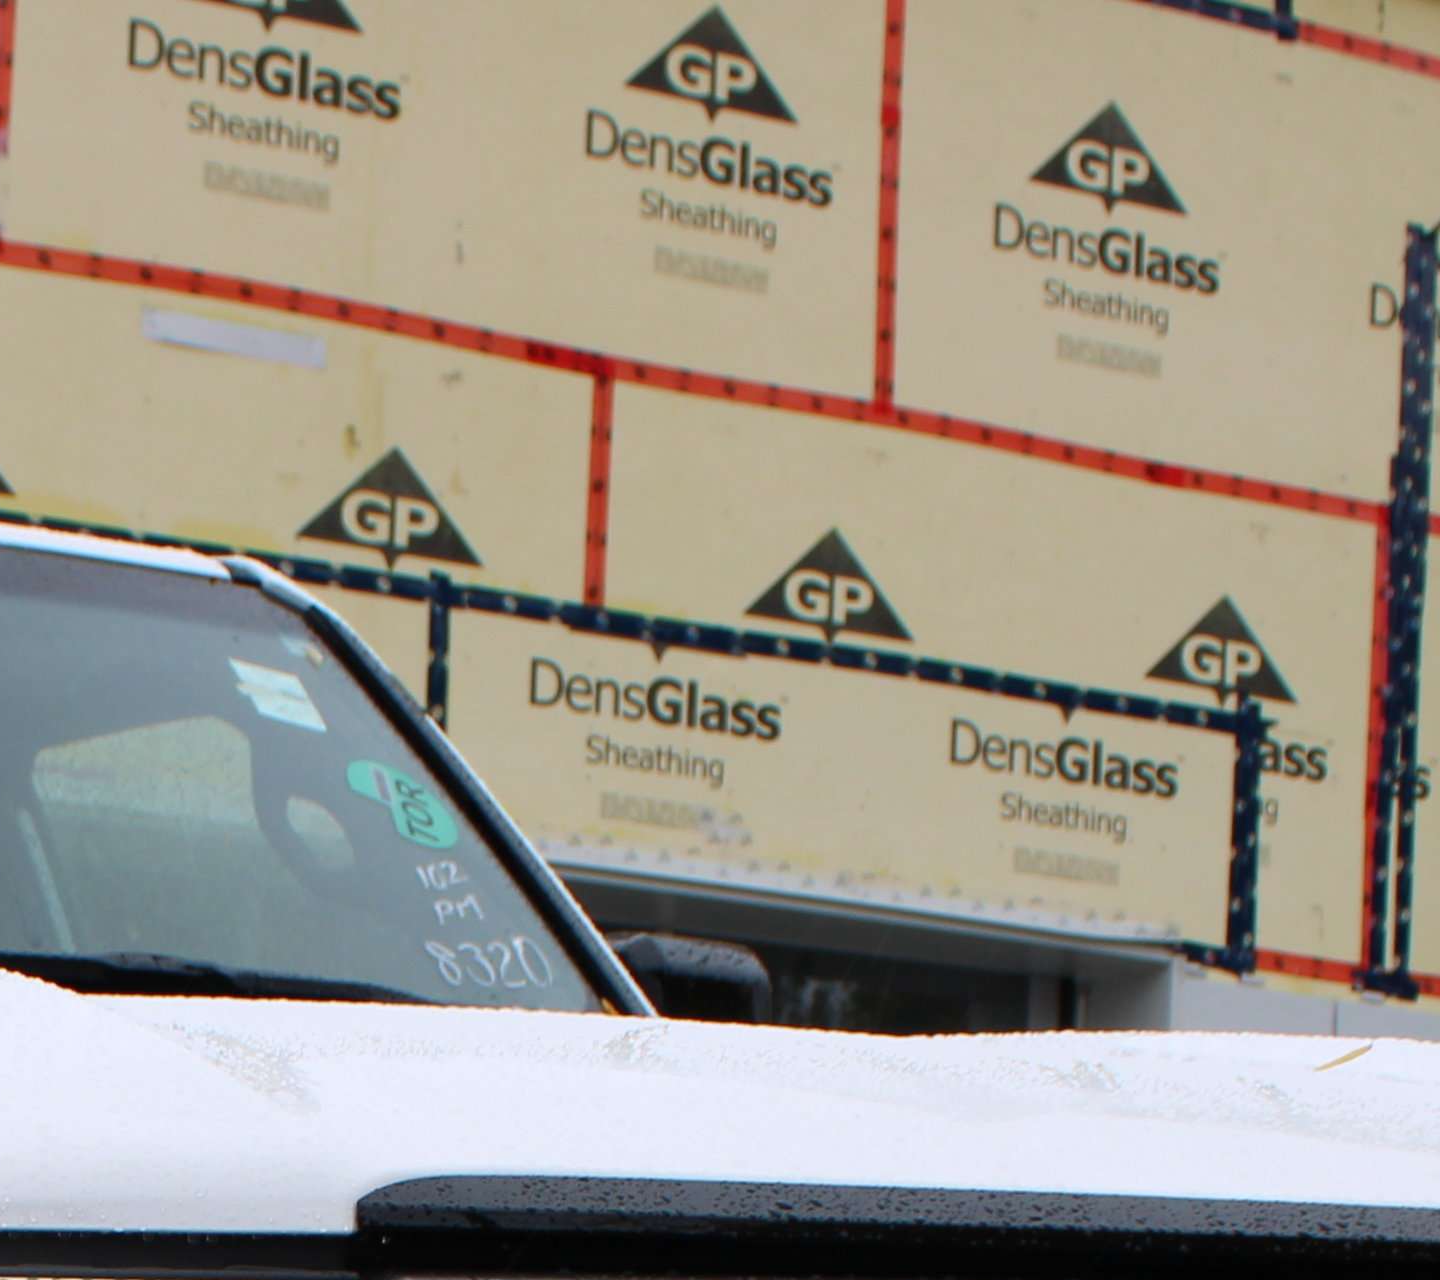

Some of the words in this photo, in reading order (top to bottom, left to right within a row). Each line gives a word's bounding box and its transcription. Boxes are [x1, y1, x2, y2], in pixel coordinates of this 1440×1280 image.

[127, 17, 402, 122] DensGlass
[665, 43, 758, 105] GP
[188, 100, 340, 164] Sheathing
[585, 107, 834, 209] DensGlass
[1065, 137, 1151, 197] GP
[640, 187, 778, 251] Sheathing
[992, 201, 1221, 296] DensGlass
[1043, 278, 1170, 337] Sheathing
[339, 487, 440, 550] GP
[783, 568, 875, 628] GP
[1180, 633, 1263, 689] GP
[528, 655, 783, 742] DensGlass
[585, 734, 726, 789] Sheathing
[950, 716, 1181, 801] DensGlass
[1000, 790, 1128, 844] Sheathing
